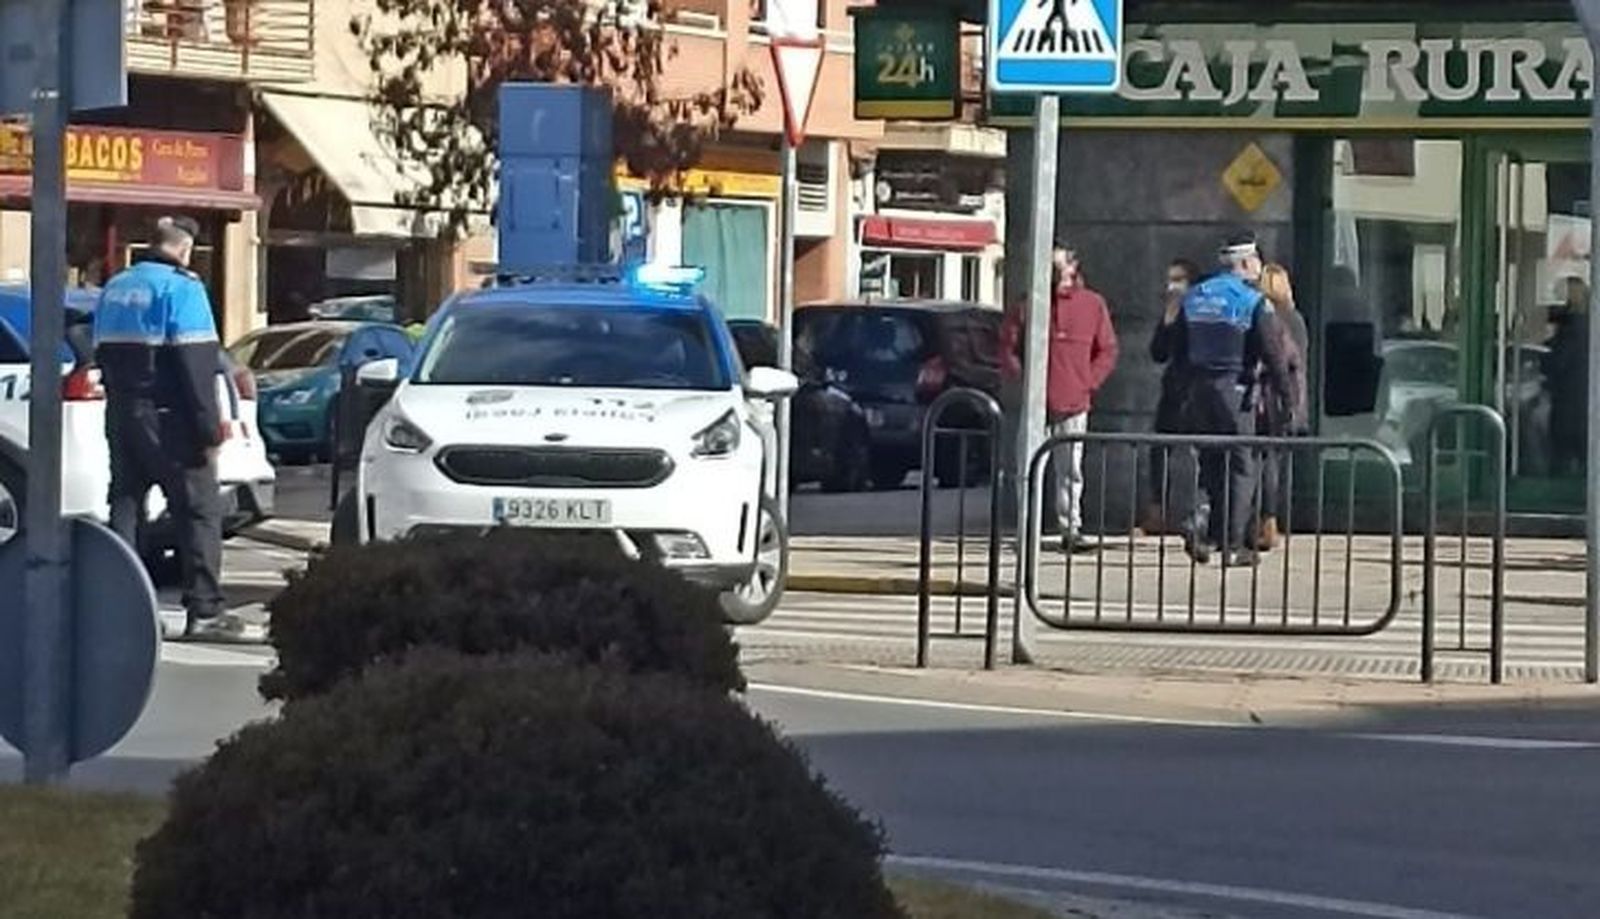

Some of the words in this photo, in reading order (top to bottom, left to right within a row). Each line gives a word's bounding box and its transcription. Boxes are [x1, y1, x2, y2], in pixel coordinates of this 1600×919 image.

[877, 51, 935, 88] 24h
[1119, 39, 1319, 105] CAJA
[1361, 37, 1594, 101] RURA
[507, 499, 559, 520] 9326
[566, 499, 608, 520] KLT
